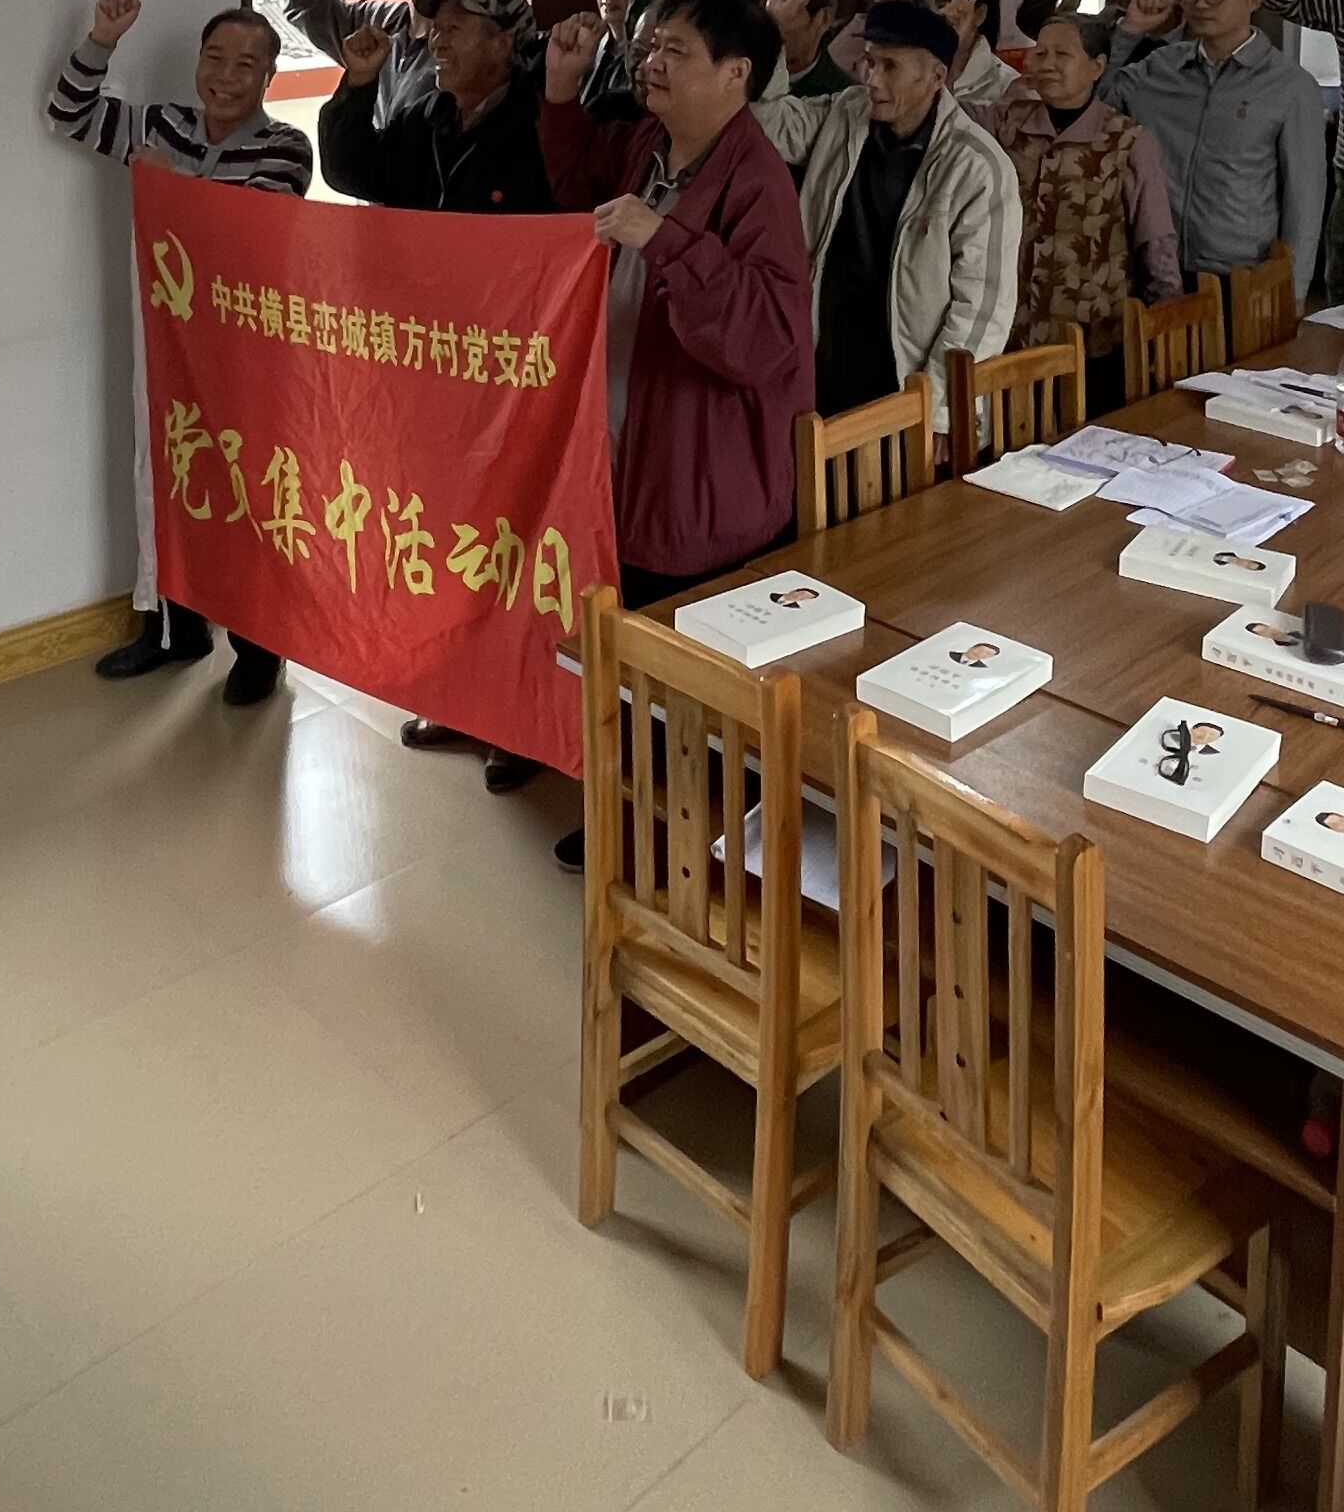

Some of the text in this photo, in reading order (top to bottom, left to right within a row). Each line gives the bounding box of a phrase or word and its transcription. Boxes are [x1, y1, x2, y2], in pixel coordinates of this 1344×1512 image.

[211, 274, 557, 389] 中共横县峦城镇方村党支部
[164, 399, 575, 634] 党员集中活动日
